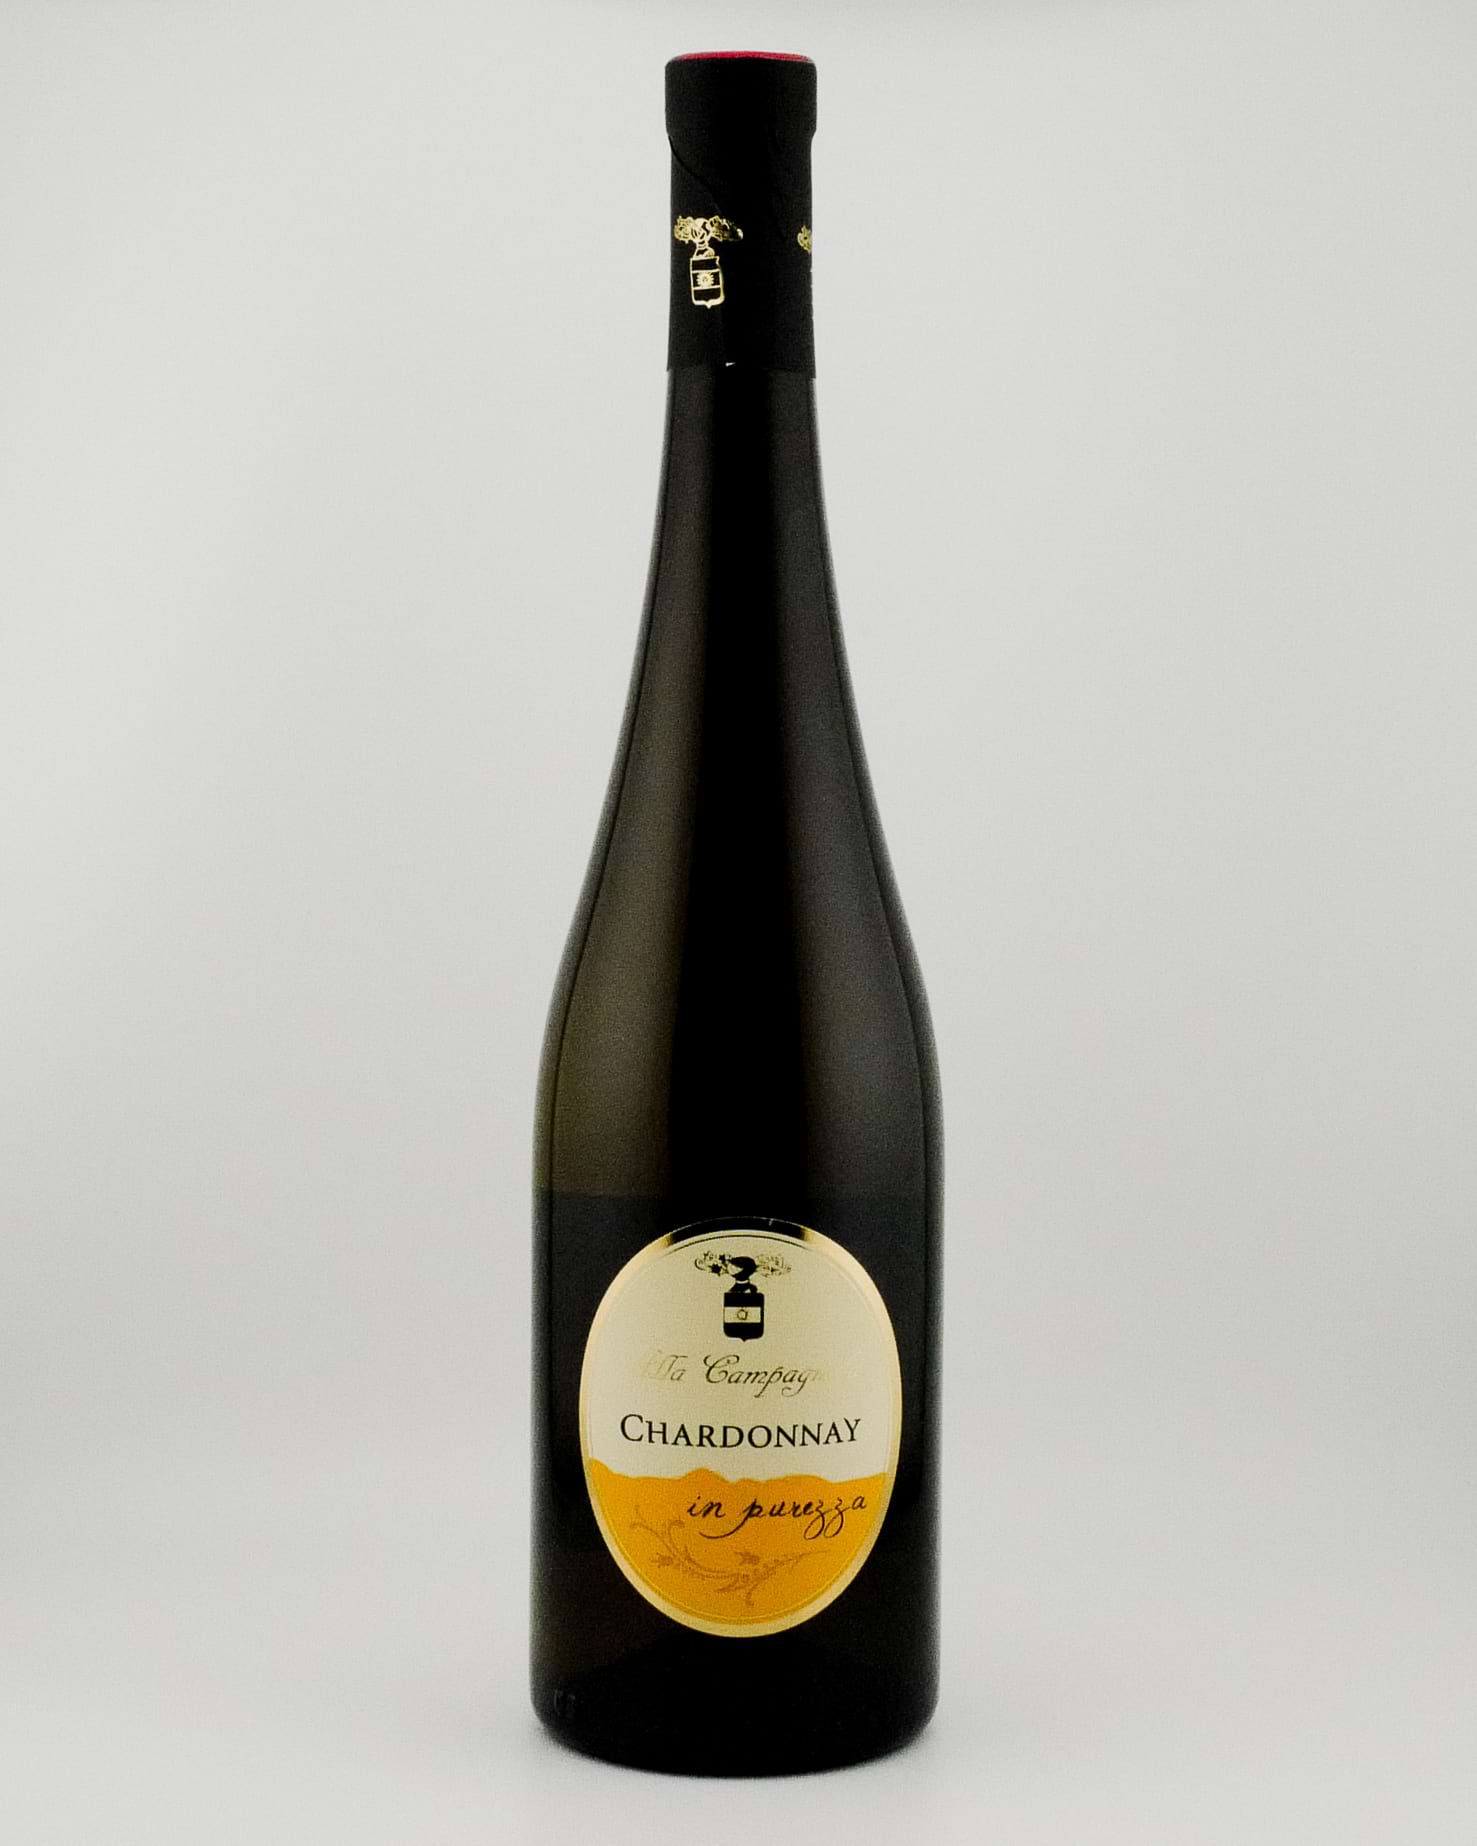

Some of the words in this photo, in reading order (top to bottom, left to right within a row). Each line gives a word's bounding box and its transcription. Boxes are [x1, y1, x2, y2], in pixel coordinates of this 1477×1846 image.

[620, 1414, 861, 1448] CHARDONNAY
[687, 1496, 725, 1518] in
[700, 1496, 866, 1540] purezza
